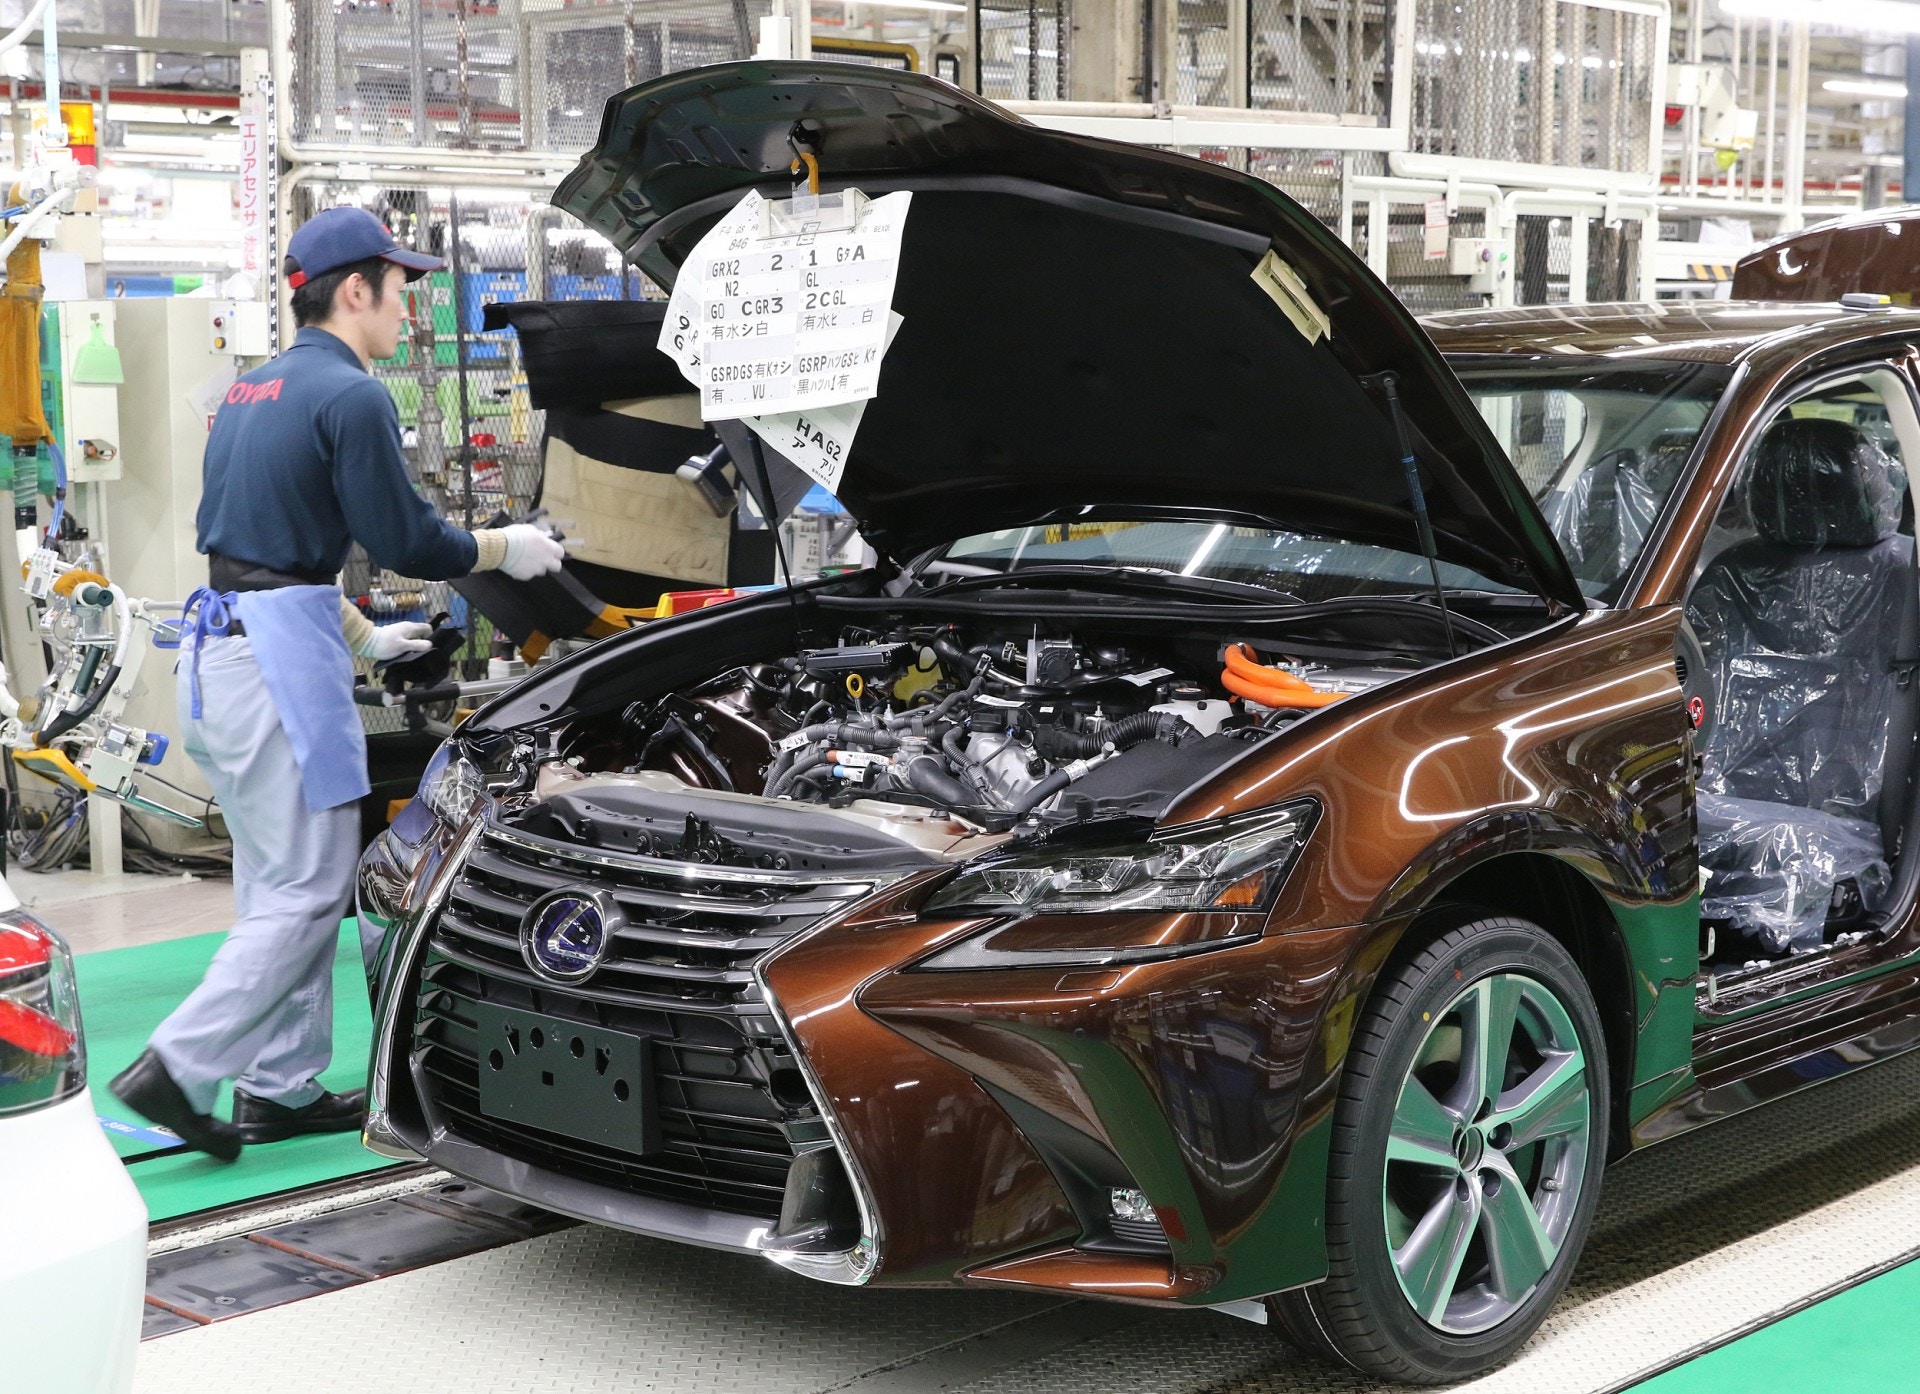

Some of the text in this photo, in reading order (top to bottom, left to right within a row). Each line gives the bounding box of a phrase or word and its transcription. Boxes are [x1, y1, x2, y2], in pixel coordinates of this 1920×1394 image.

[243, 123, 257, 227] エリアセンサ
[728, 237, 749, 251] 846
[712, 254, 783, 277] GRX2 2
[808, 249, 818, 266] 1
[806, 272, 819, 288] GL
[725, 281, 739, 297] N2
[861, 307, 873, 324] 白
[222, 378, 284, 405] OYOTA
[711, 387, 725, 404] 有
